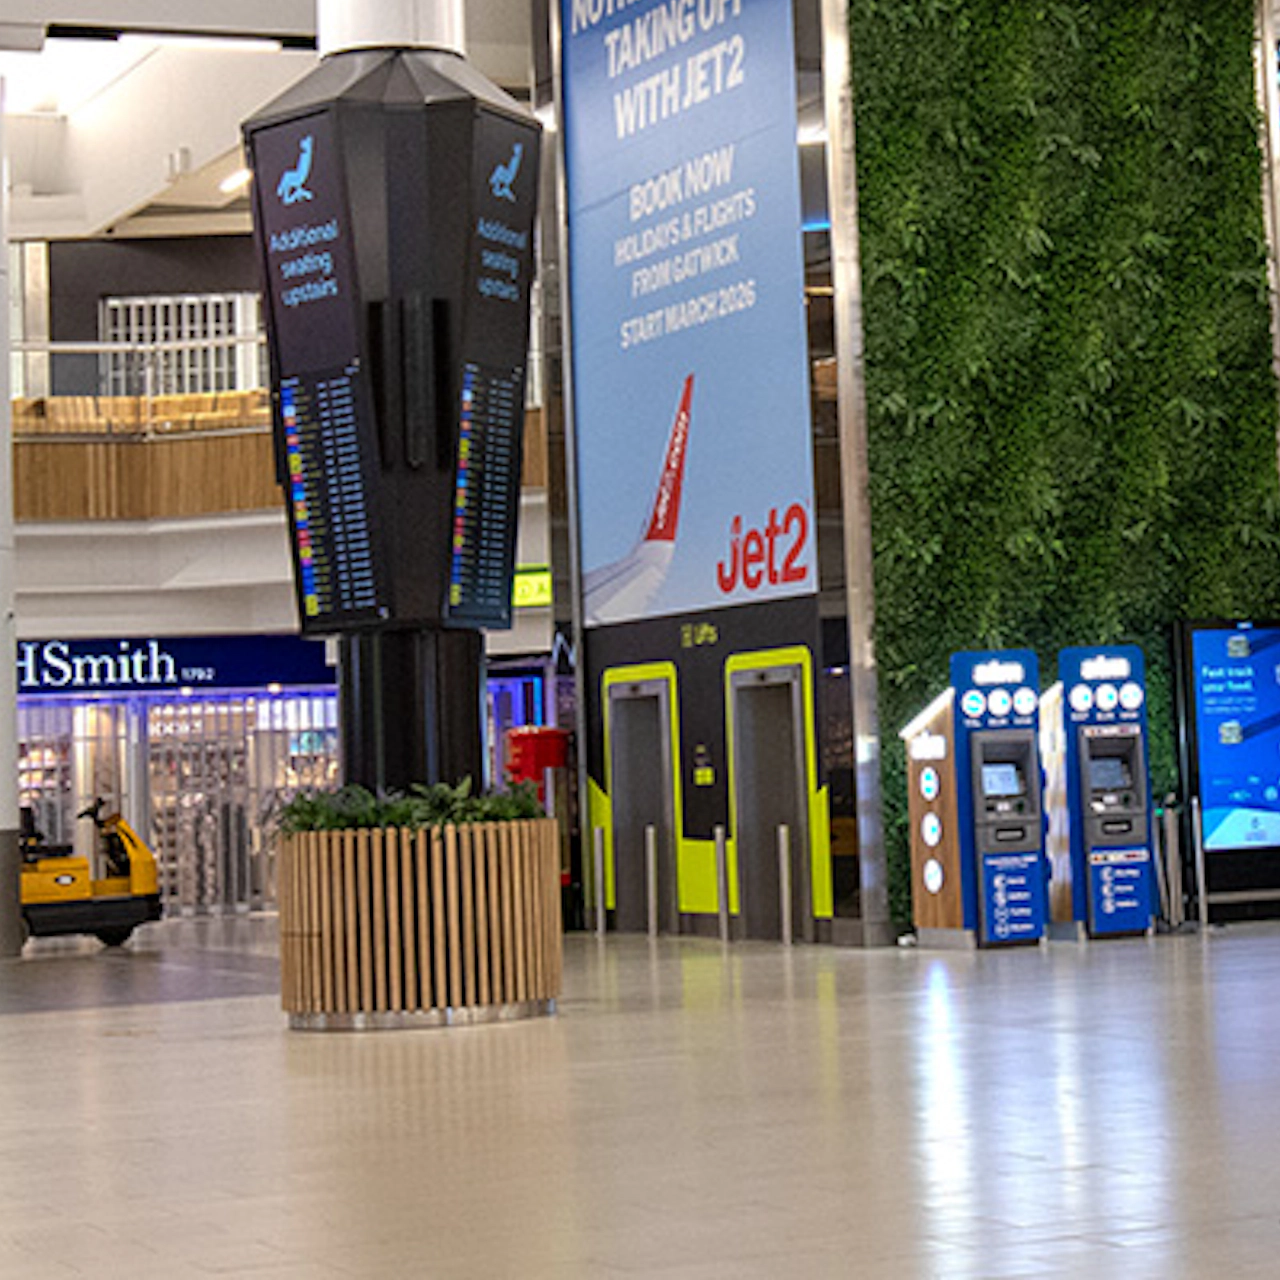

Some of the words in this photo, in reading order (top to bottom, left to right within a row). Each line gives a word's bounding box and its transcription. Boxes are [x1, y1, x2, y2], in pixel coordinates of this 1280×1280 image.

[614, 65, 680, 139] WITH
[683, 33, 744, 110] JET2
[629, 166, 682, 222] BOOK
[683, 144, 735, 199] NOW
[270, 219, 337, 254] Additional
[614, 216, 680, 267] HOLIDAYS
[694, 187, 756, 237] FLIGHTS
[280, 251, 331, 280] seating
[281, 279, 337, 307] upstairs
[631, 260, 673, 299] FROM
[674, 233, 740, 283] GATWICK
[620, 308, 664, 350] START
[665, 291, 718, 334] MARCH
[719, 280, 756, 317] 2026
[716, 502, 808, 594] jet2
